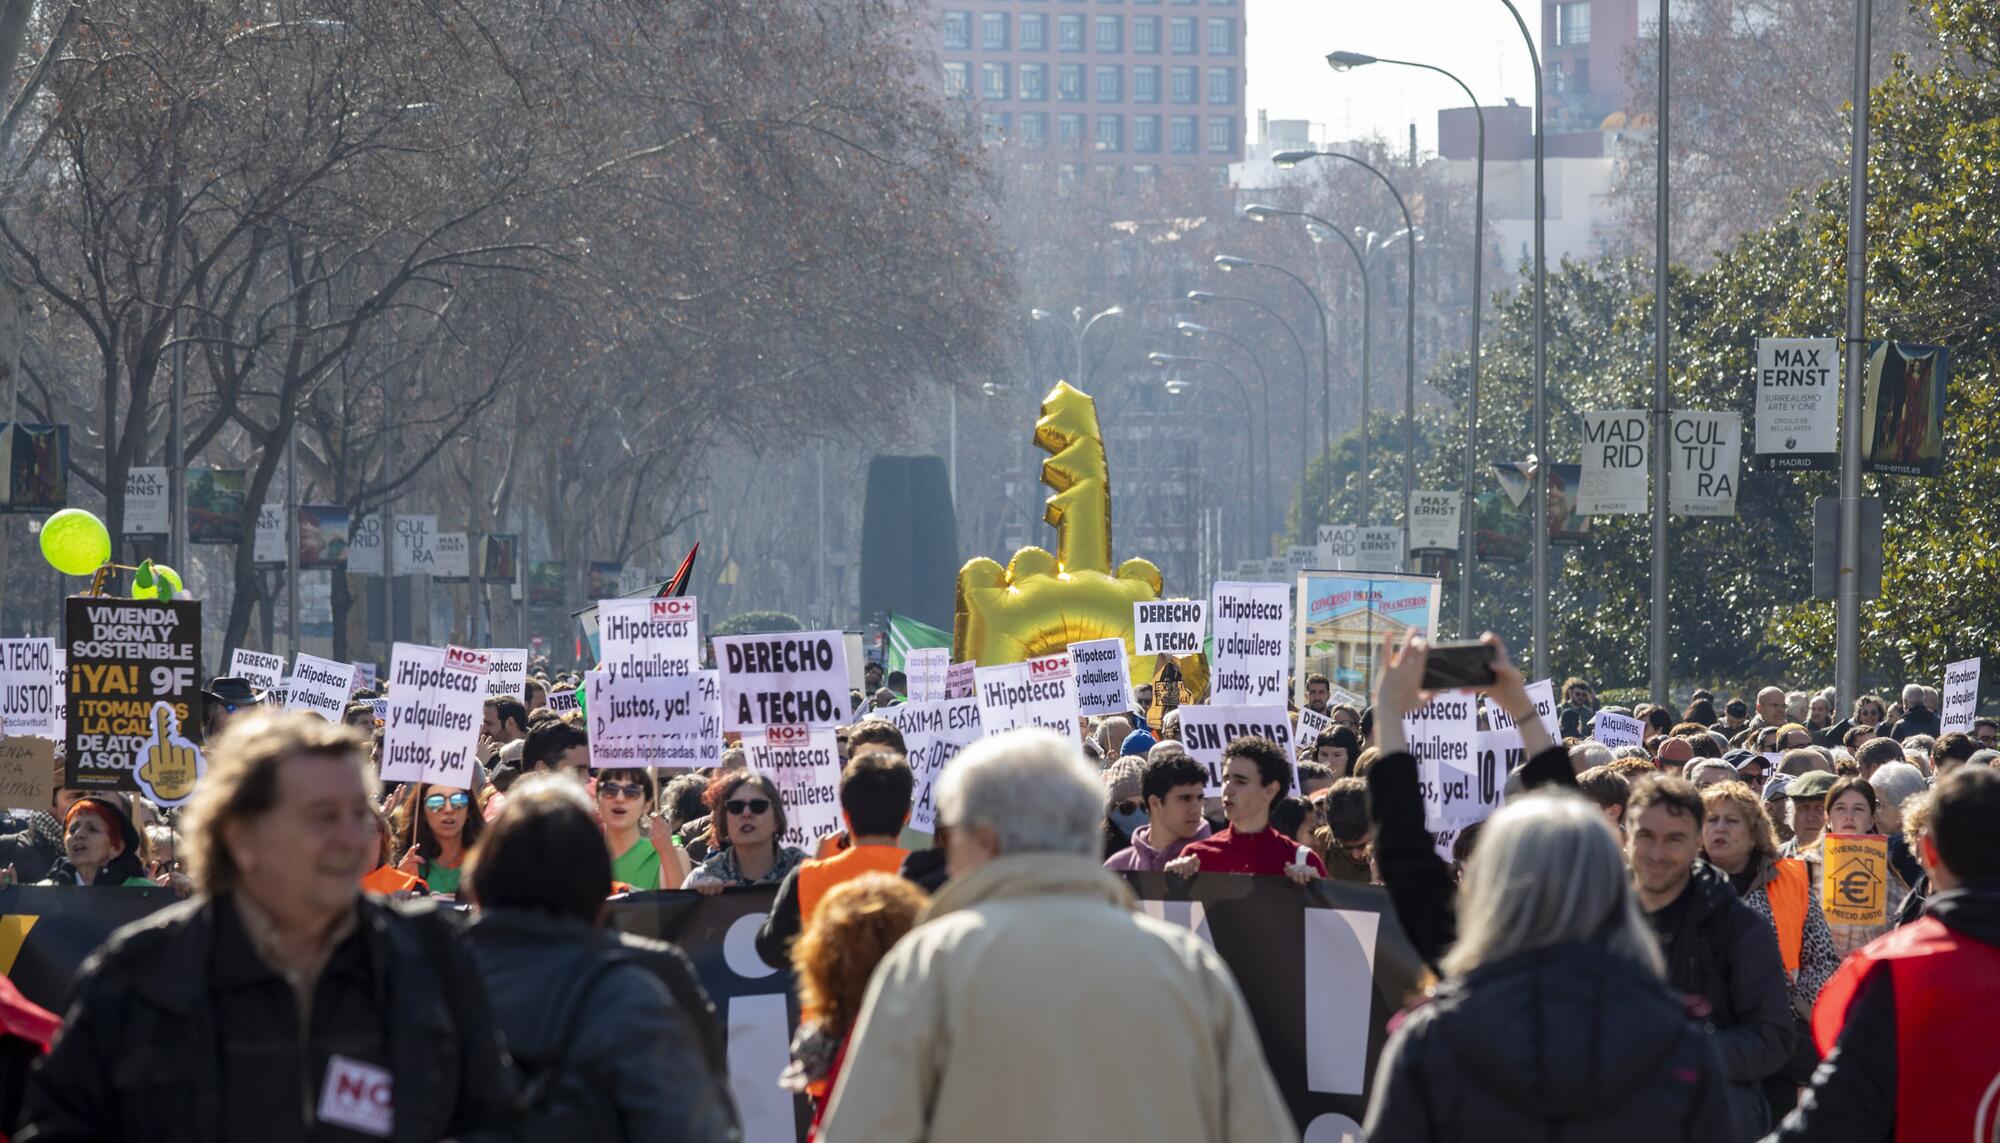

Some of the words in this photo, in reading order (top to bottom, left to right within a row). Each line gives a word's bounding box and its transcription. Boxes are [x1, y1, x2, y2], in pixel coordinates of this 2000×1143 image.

[1774, 349, 1821, 368] MAX
[1763, 369, 1830, 387] ERNST
[1765, 394, 1821, 403] SURREALISMO
[1767, 403, 1787, 412] ARTE
[1789, 403, 1795, 411] Y
[1797, 403, 1816, 411] CINE
[1583, 419, 1645, 443] MAD
[1674, 420, 1726, 446] CUL
[1603, 445, 1643, 468] RID
[1682, 446, 1716, 471] TU
[1779, 459, 1812, 467] MADRID
[1874, 463, 1921, 474] max-ernst.es
[127, 485, 164, 496] RNST
[1698, 473, 1732, 497] RA
[1421, 497, 1450, 505] MAX
[260, 510, 275, 519] AX
[1414, 506, 1456, 515] ERNST
[257, 520, 280, 529] NST
[359, 519, 380, 533] AD
[396, 520, 429, 534] CUL
[354, 534, 380, 548] RID
[404, 535, 424, 549] TU
[1318, 530, 1356, 543] MAD
[1366, 532, 1391, 540] MAX
[1331, 543, 1356, 556] RID
[1360, 541, 1397, 550] ERNST
[412, 550, 434, 564] RA
[87, 606, 180, 626] VIVIENDA
[653, 601, 692, 614] NO+
[1140, 604, 1201, 623] DERECHO
[1218, 595, 1283, 623] ¡Hipotecas
[93, 624, 157, 642] DIGNA
[157, 626, 174, 642] Y
[607, 615, 688, 644] ¡Hipotecas
[1144, 633, 1152, 651] A
[1155, 631, 1198, 651] TECHO.
[1217, 638, 1225, 657] y
[1227, 631, 1282, 660] alquileres
[72, 640, 194, 661] SOSTENIBLE
[448, 648, 488, 665] NO+
[725, 638, 833, 674] DERECHO
[1073, 648, 1116, 664] ¡Hipotecas
[236, 652, 279, 670] DERECHO
[489, 659, 523, 675] potecas
[608, 661, 617, 685] y
[621, 652, 689, 682] alquileres
[1031, 657, 1070, 674] NO+
[71, 664, 139, 695] ¡YA!
[150, 666, 195, 696] 9F
[243, 672, 275, 688] TECHO.
[296, 663, 347, 689] ¡Hipotecas
[397, 660, 479, 694] ¡Hipotecas
[1075, 674, 1081, 687] y
[1082, 669, 1119, 686] alquileres
[1216, 667, 1255, 694] justos,
[1258, 669, 1280, 696] ya!
[485, 679, 521, 696] lquileres
[984, 679, 1066, 709] ¡Hipotecas
[3, 685, 53, 715] JUSTO!
[290, 689, 298, 703] y
[298, 690, 341, 712] alquileres
[610, 694, 660, 723] justos,
[664, 691, 690, 721] ya!
[737, 692, 753, 725] A
[757, 688, 841, 725] TECHO.
[1078, 693, 1105, 708] justos,
[1106, 689, 1121, 707] ya!
[1945, 695, 1951, 708] y
[3, 718, 49, 728] Esclavitud.
[391, 705, 402, 724] y
[404, 700, 473, 731] alquileres
[83, 717, 110, 734] LA
[768, 727, 806, 740] NO+
[77, 734, 105, 751] DE
[1184, 723, 1222, 750] SIN
[388, 738, 436, 767] justos,
[439, 746, 468, 773] ya!
[593, 744, 635, 760] Prisiones
[636, 744, 698, 762] hipotecadas,
[700, 745, 718, 760] NO!
[1406, 734, 1468, 765] lquileres
[78, 752, 95, 769] A
[95, 752, 137, 770] SOL
[752, 745, 830, 773] ¡Hipotecas
[1443, 774, 1469, 805] ya!
[1828, 844, 1863, 856] VIVIENDA
[1863, 846, 1886, 860] DIGNA
[1832, 908, 1858, 920] PRECIO
[1859, 909, 1883, 920] JUSTO
